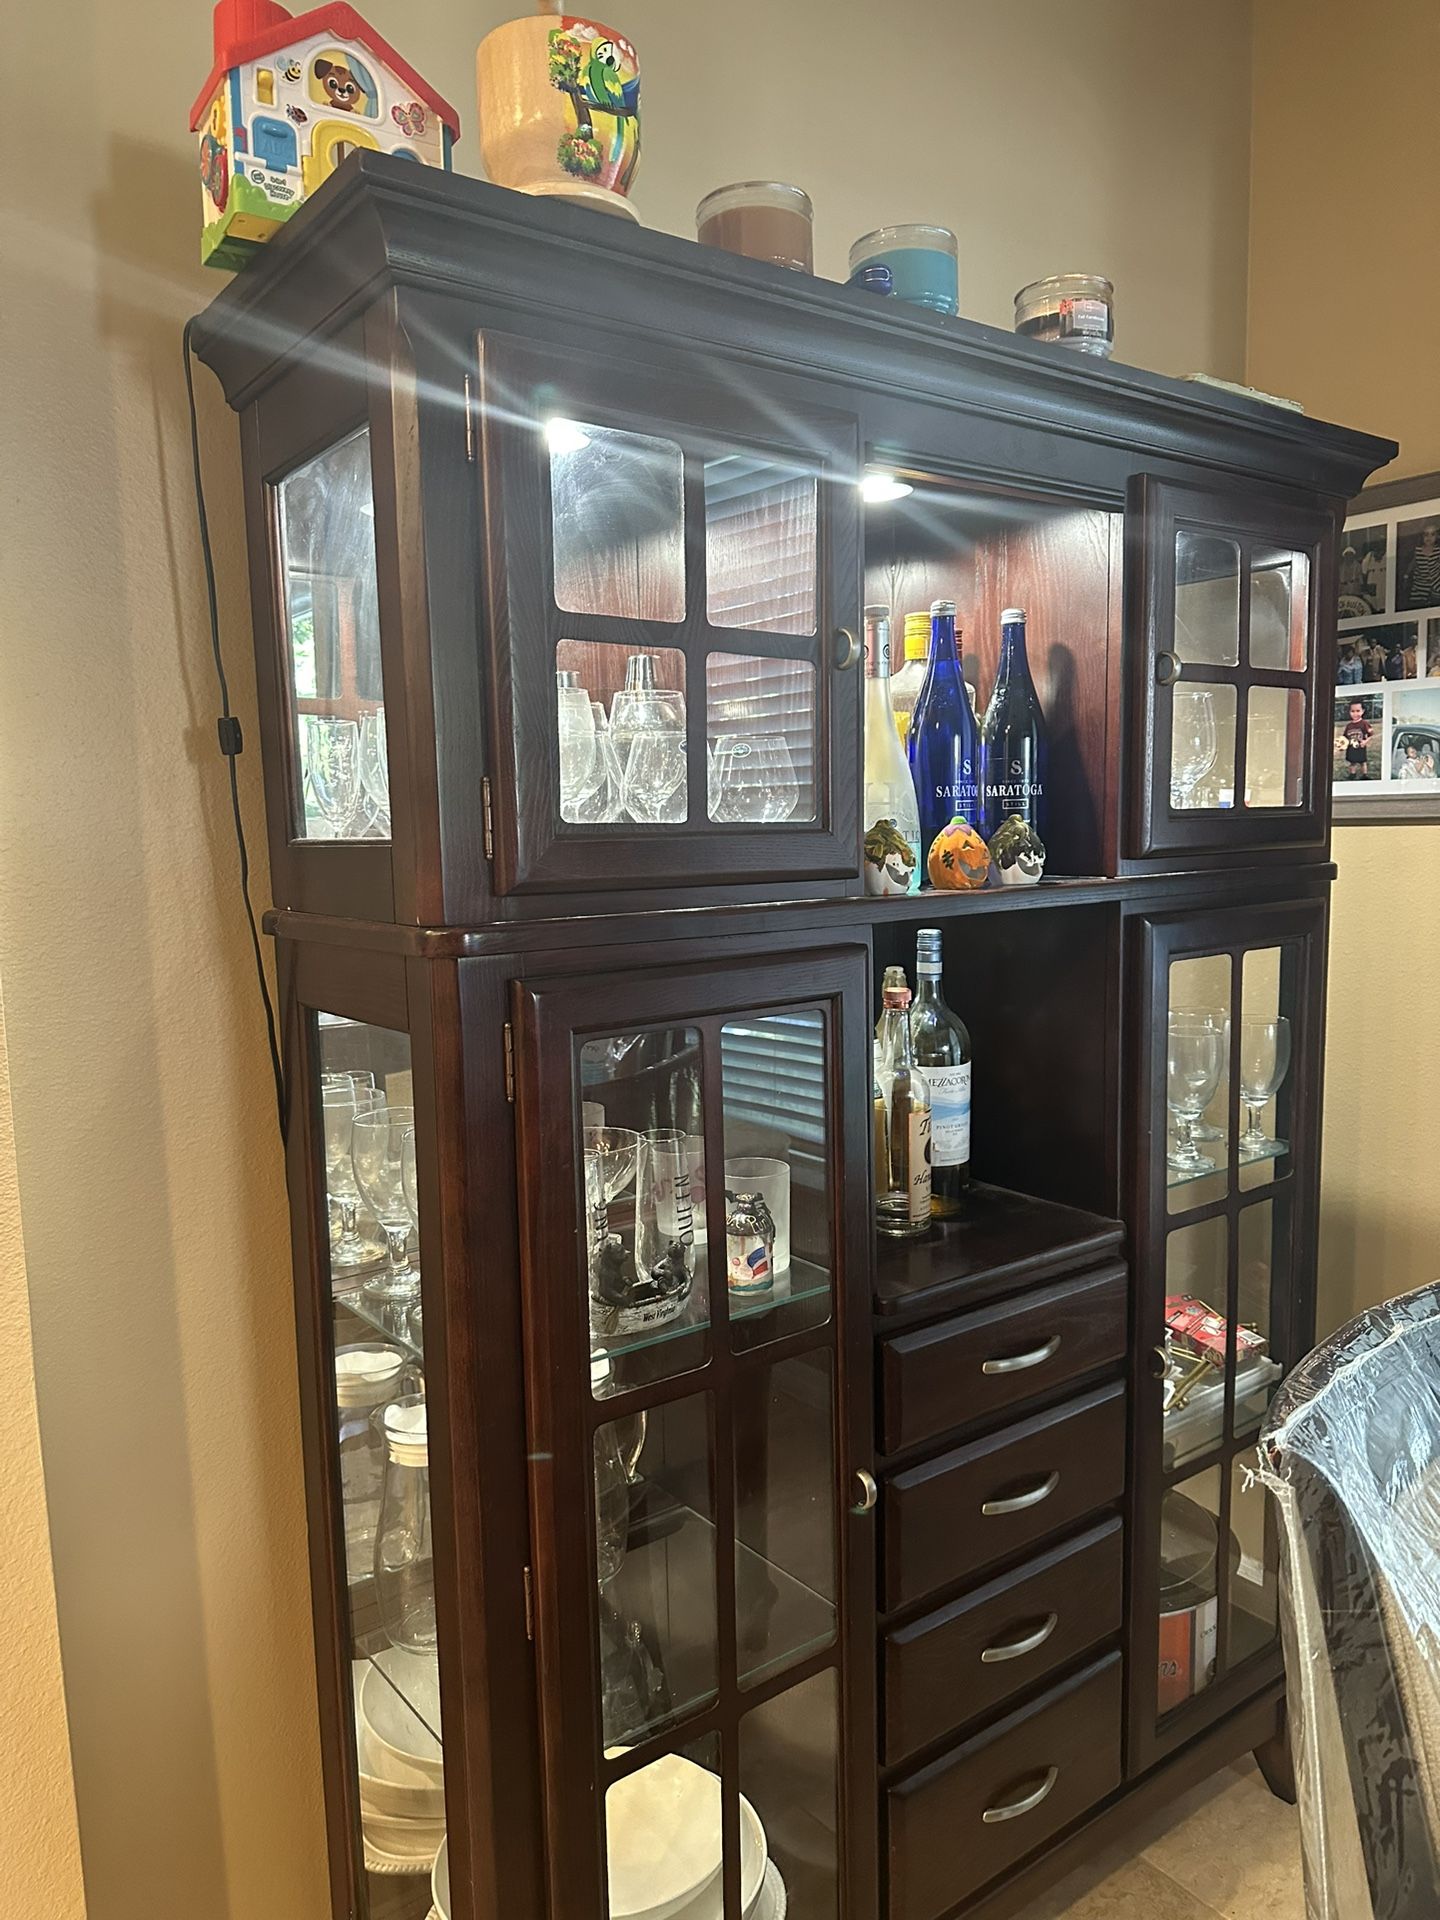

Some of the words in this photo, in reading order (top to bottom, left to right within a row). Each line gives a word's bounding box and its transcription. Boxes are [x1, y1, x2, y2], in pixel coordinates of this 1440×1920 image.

[935, 784, 978, 798] SARATO
[986, 783, 1043, 797] SARATOGA
[674, 1174, 694, 1247] QUEEN
